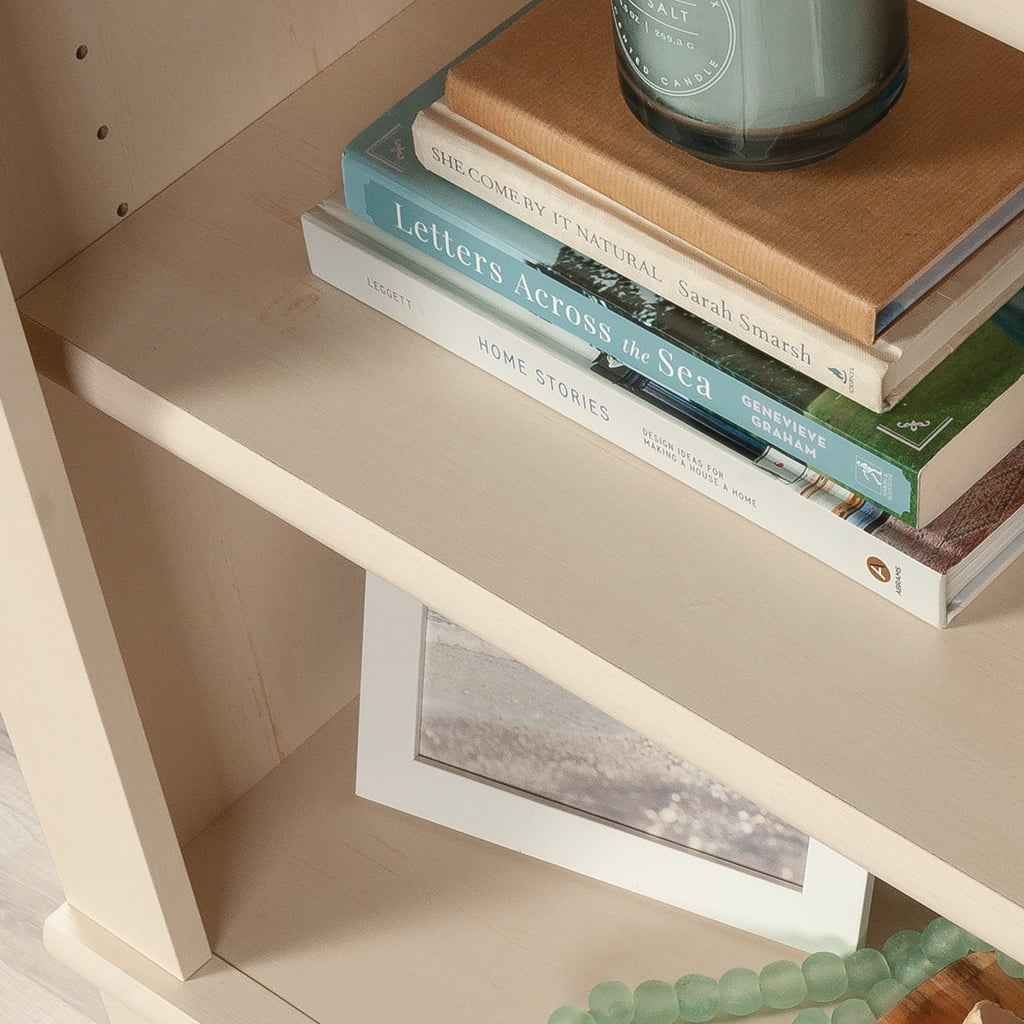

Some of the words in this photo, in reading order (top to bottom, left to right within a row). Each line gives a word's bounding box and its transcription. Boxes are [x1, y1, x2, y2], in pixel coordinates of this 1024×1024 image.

[647, 0, 688, 22] SALT
[660, 59, 719, 87] CANDLE
[431, 146, 465, 176] SHE
[467, 167, 521, 205] COME
[523, 196, 546, 217] BY
[552, 209, 572, 231] IT
[576, 223, 663, 283] NATURAL
[677, 279, 732, 323] Sarah
[739, 313, 812, 366] Smarsh
[393, 201, 503, 284] Letters
[513, 271, 612, 344] Across
[622, 338, 650, 365] the
[657, 347, 713, 401] Sea
[366, 277, 412, 310] LEGGETT
[478, 335, 528, 376] HOME
[535, 368, 610, 422] STORIES
[741, 394, 827, 449] GENEVIEVE
[751, 414, 817, 459] GRAHAM
[642, 427, 674, 451] DESIGN
[677, 447, 704, 468] IDEAS
[707, 463, 724, 480] FOR
[643, 438, 677, 463] MAKING
[689, 464, 719, 486] HOUSE
[723, 483, 728, 491] A
[732, 487, 758, 508] HOME
